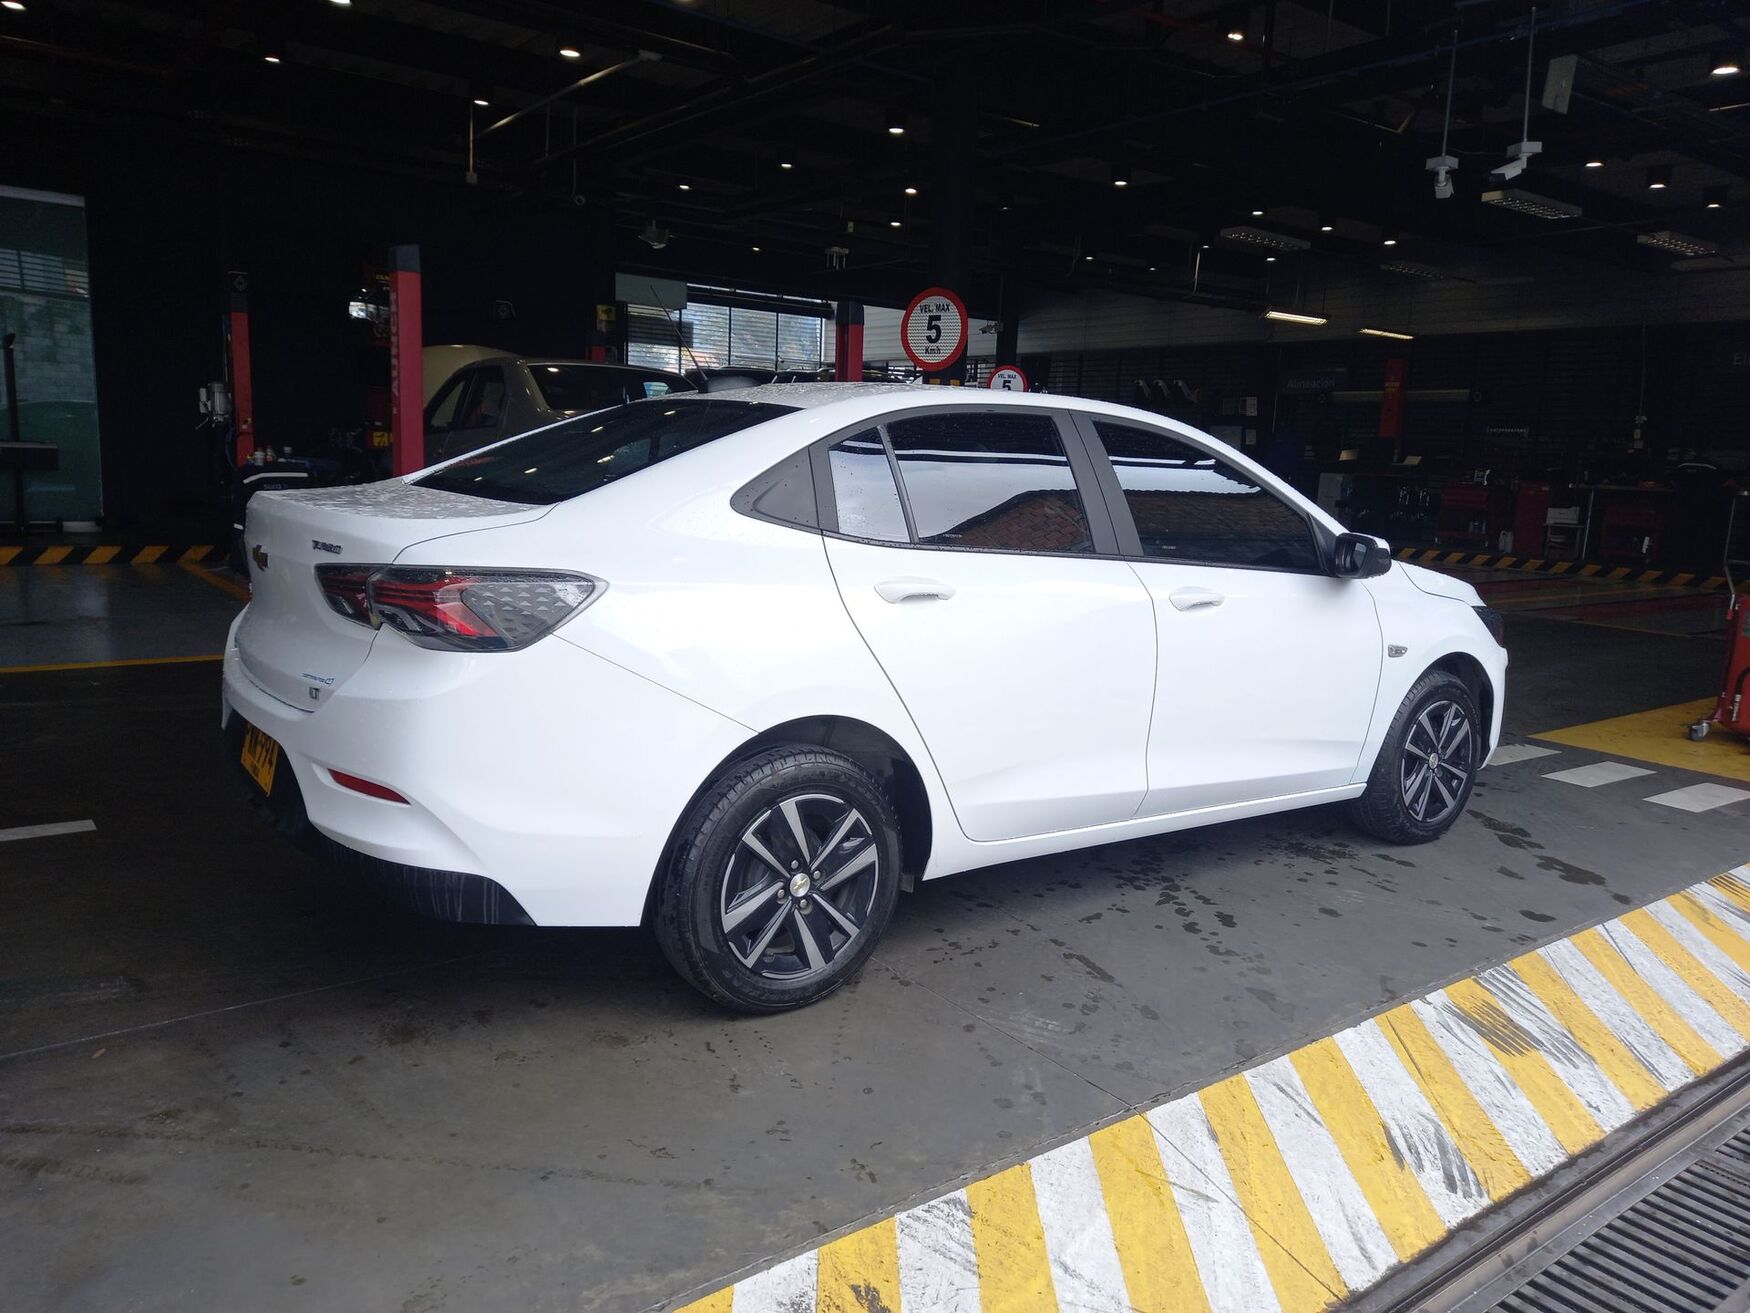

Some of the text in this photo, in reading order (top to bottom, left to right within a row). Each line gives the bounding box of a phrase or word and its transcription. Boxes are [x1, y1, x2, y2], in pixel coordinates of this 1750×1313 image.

[919, 303, 950, 313] VEL. MAX
[926, 315, 942, 343] 5
[1002, 379, 1012, 391] 5
